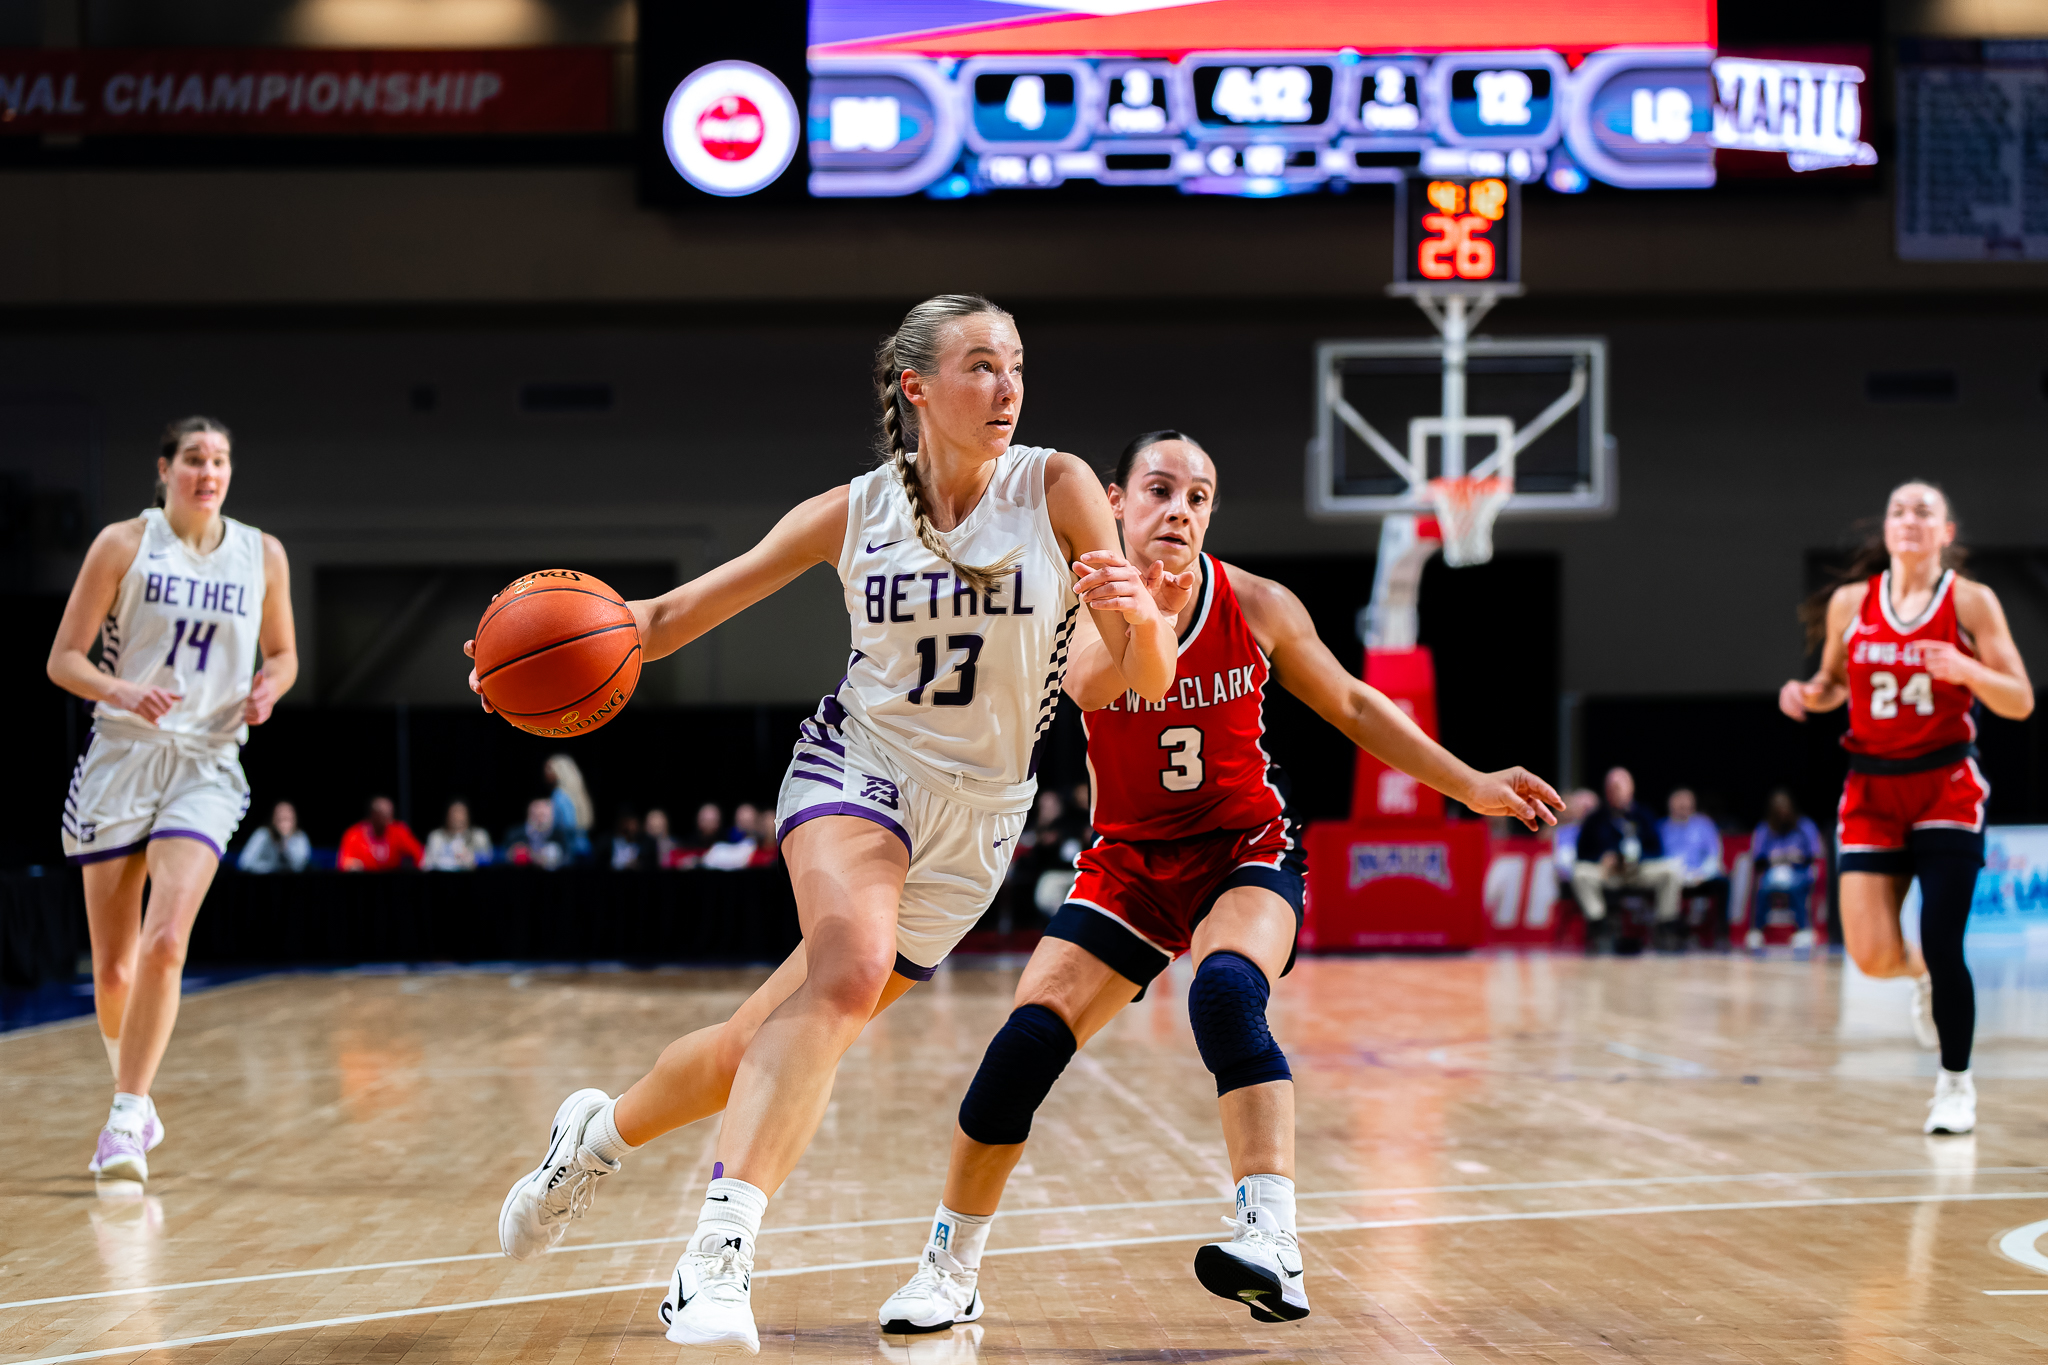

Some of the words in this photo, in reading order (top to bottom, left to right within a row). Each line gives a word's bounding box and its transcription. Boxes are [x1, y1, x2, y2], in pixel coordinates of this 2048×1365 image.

[102, 70, 502, 116] CHAMPIONSHIP
[1005, 76, 1047, 130] 4
[1474, 70, 1532, 126] 12
[1417, 213, 1496, 280] 26
[144, 572, 248, 617] BETHEL
[865, 563, 1036, 626] BETHEL
[164, 618, 219, 672] 14
[905, 633, 986, 707] 13
[1868, 670, 1936, 720] 24
[1158, 725, 1205, 793] 3
